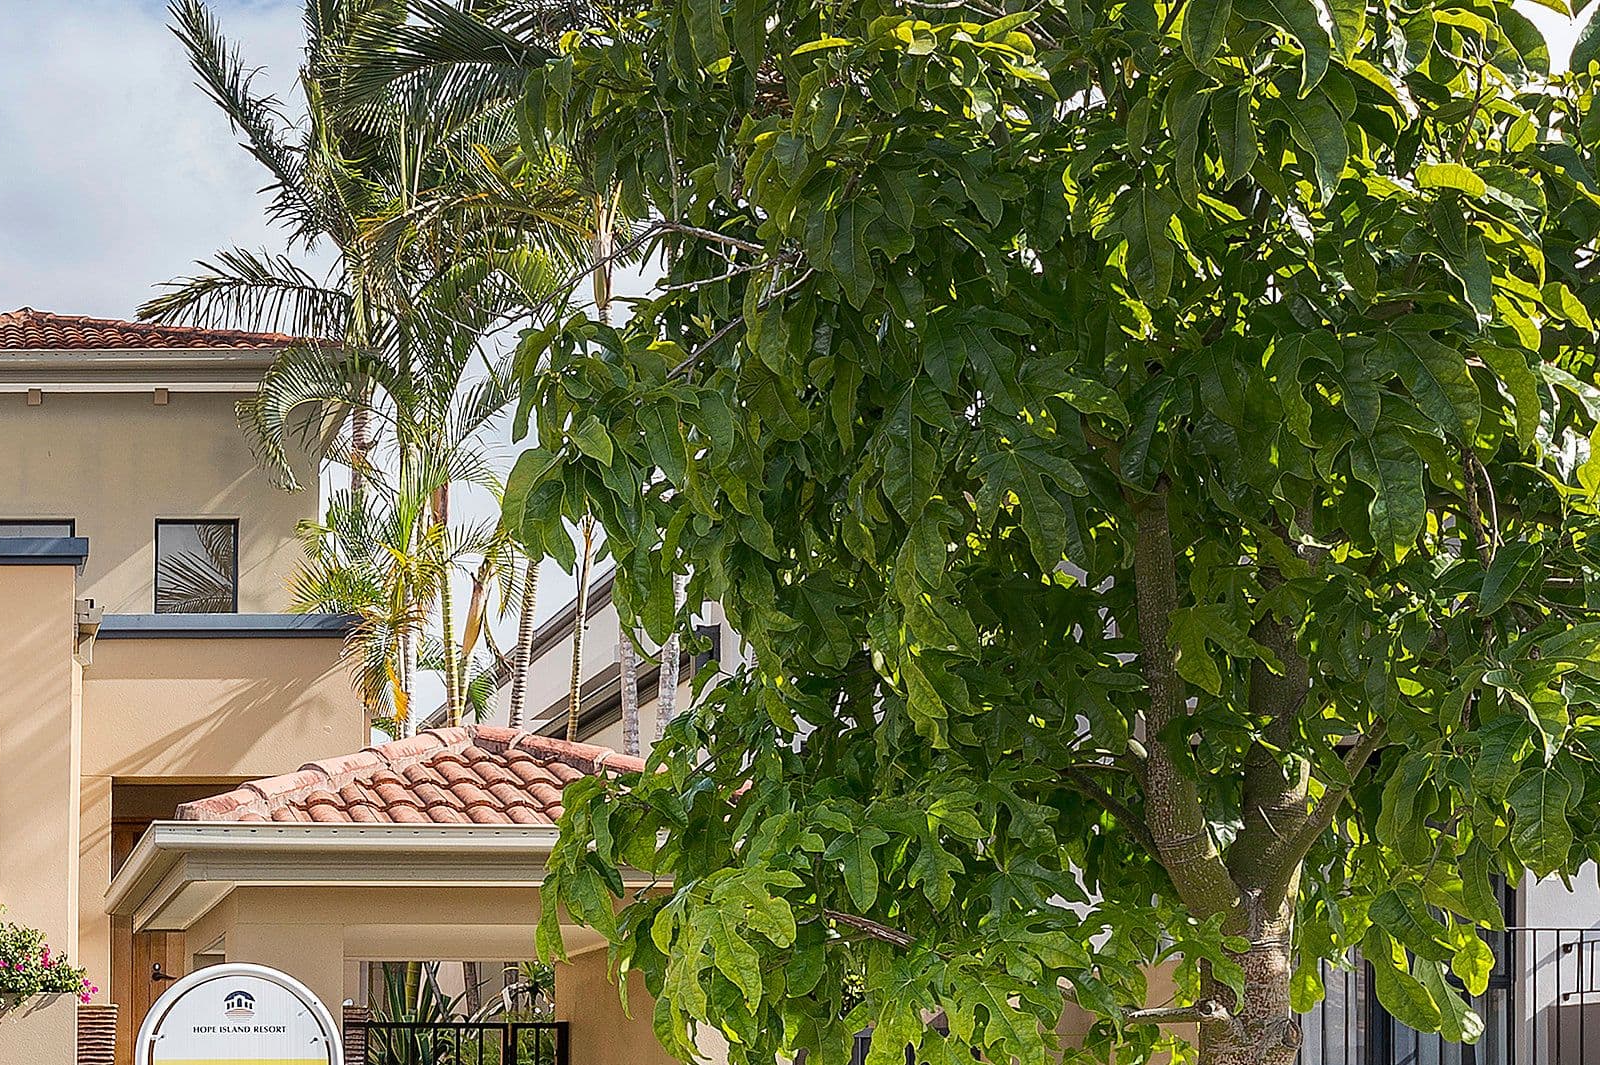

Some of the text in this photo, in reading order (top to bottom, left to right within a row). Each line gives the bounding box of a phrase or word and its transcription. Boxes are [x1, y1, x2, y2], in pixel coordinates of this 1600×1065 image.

[193, 1026, 286, 1034] HOPE ISLAND RESORT
